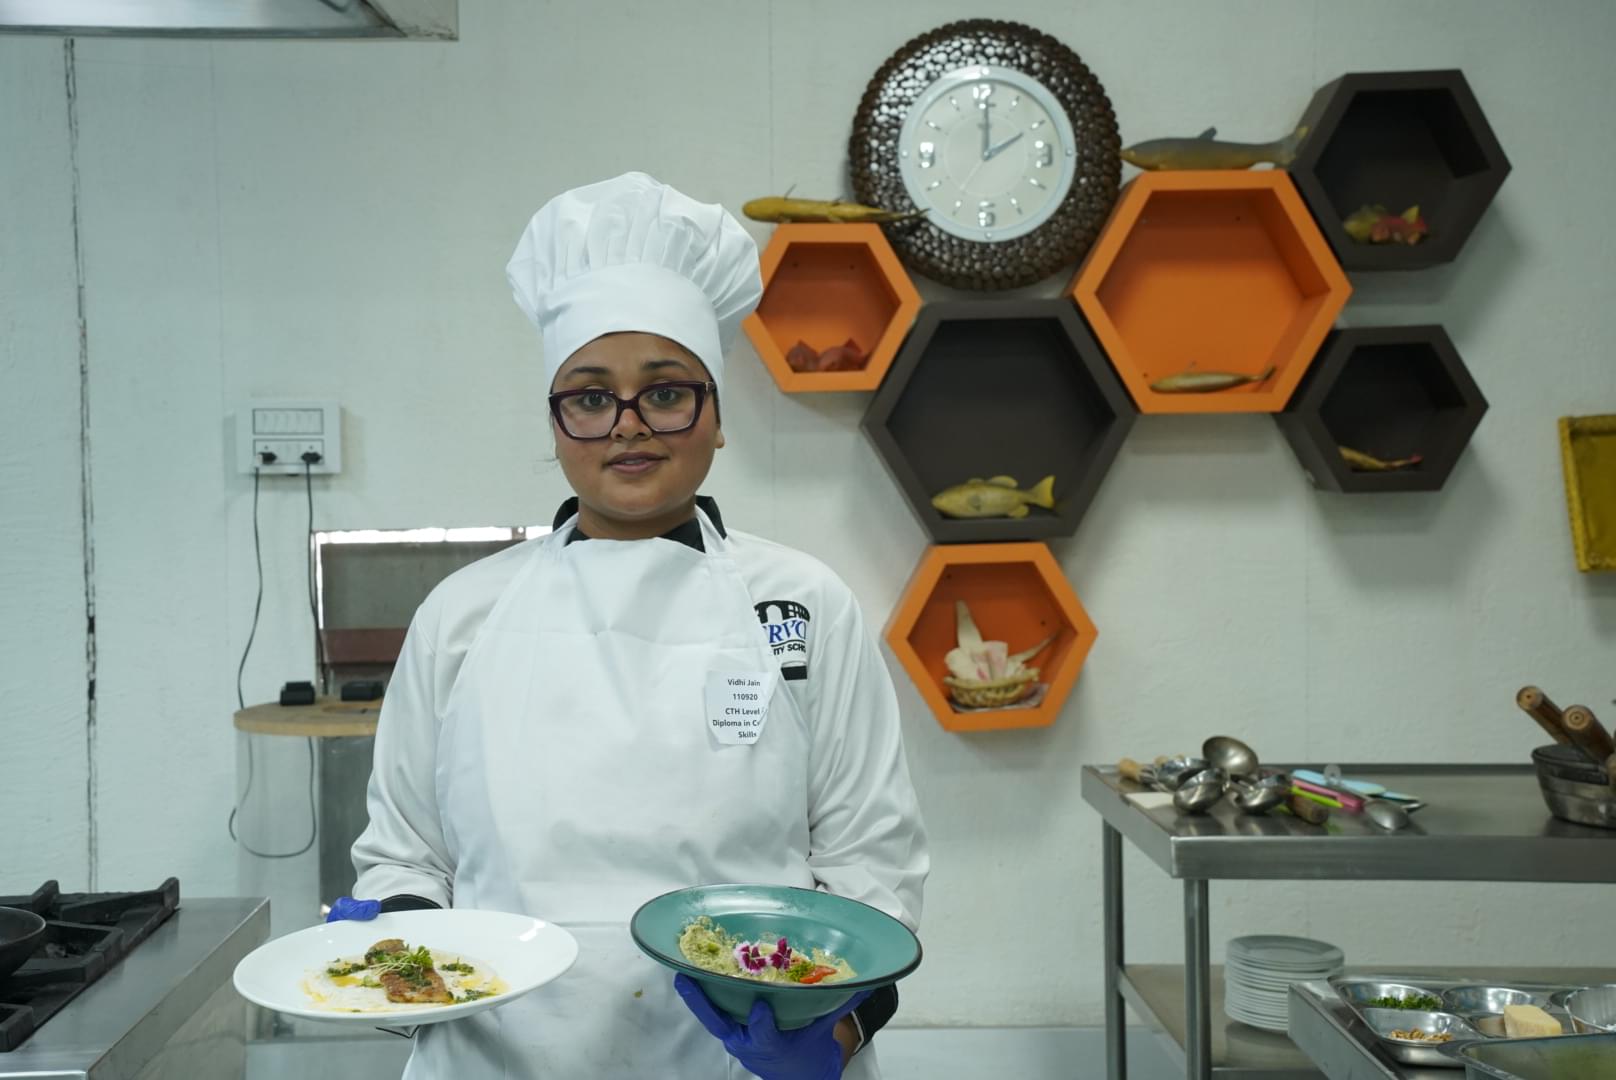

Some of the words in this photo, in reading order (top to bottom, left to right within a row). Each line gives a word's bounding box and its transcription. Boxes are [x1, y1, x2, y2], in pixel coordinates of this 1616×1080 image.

[973, 83, 997, 109] 12
[919, 141, 935, 169] 9
[1034, 140, 1053, 167] 3
[978, 200, 995, 227] 6
[746, 679, 761, 687] Jain
[733, 693, 758, 701] 110920
[725, 707, 740, 715] CTH
[742, 707, 760, 715] Level
[712, 719, 742, 728] Diploma
[743, 719, 751, 727] in
